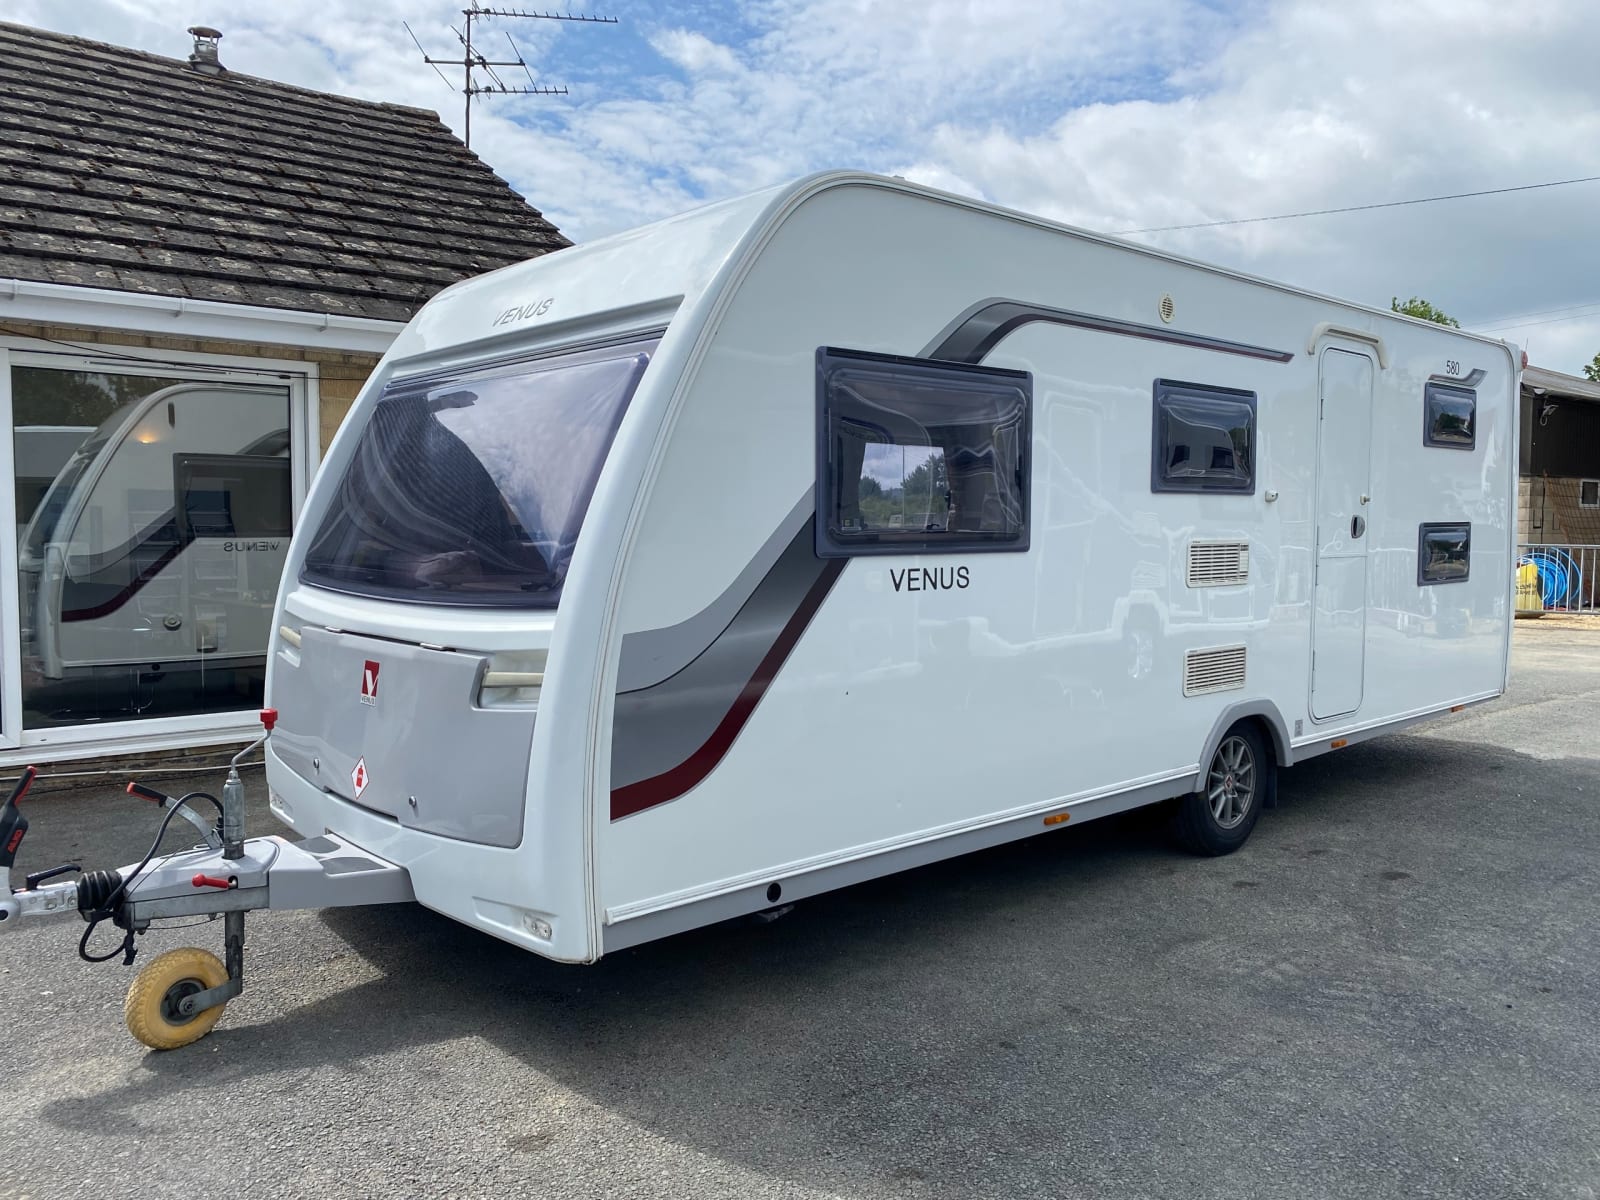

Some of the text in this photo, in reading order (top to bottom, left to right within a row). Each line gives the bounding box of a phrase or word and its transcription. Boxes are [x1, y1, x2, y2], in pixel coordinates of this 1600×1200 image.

[492, 298, 554, 327] VENUS
[1446, 360, 1460, 375] 580
[890, 566, 969, 592] VENUS
